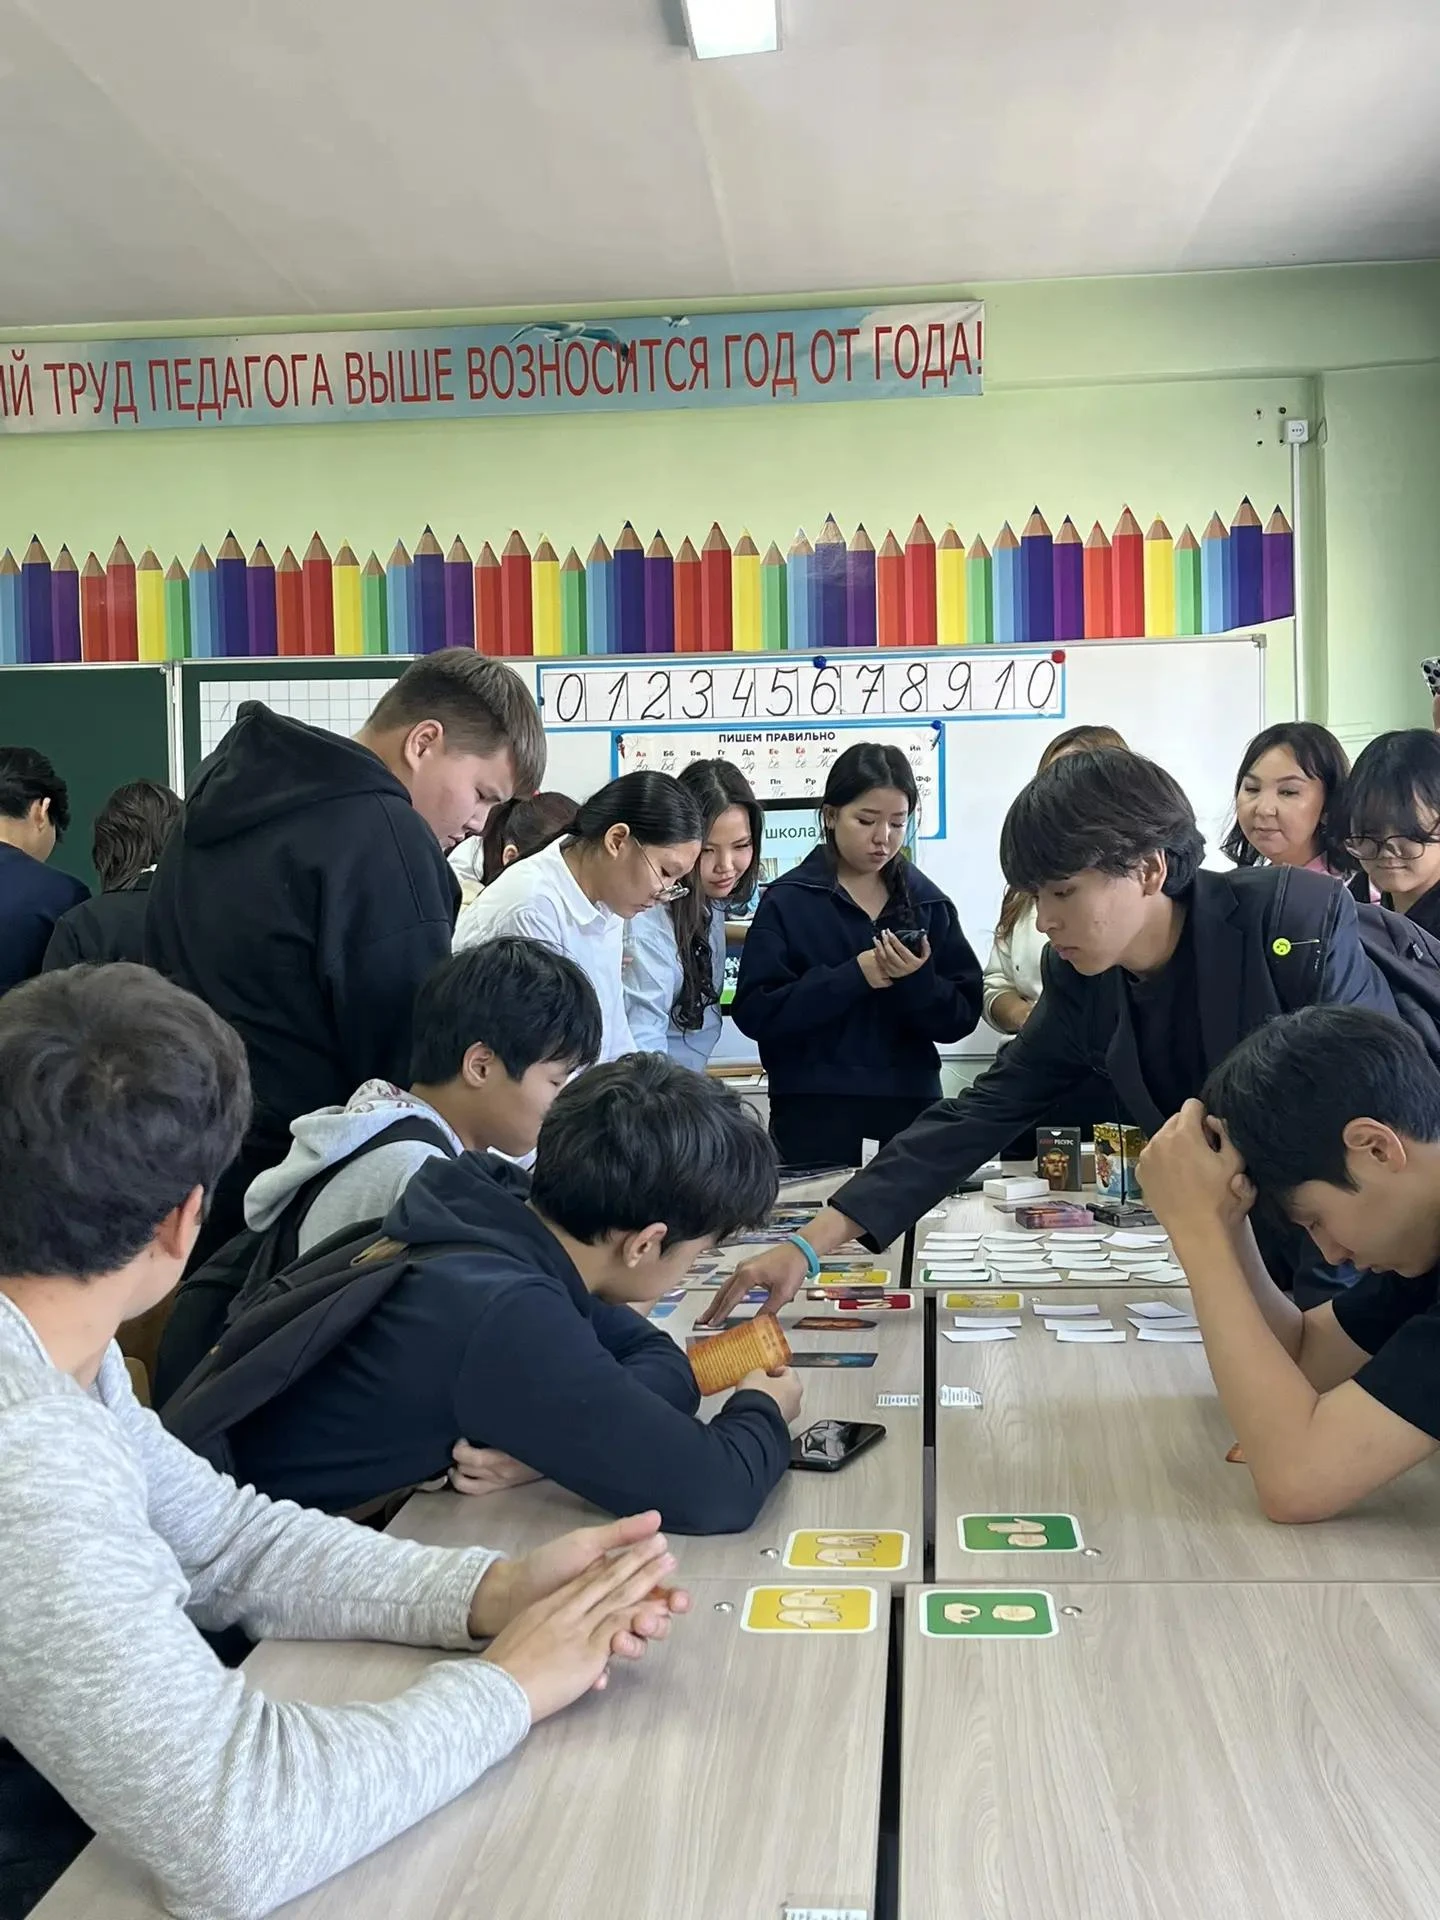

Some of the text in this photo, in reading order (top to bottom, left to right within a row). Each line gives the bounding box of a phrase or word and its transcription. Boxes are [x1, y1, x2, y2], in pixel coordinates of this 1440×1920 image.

[43, 360, 139, 424] ТРУД
[148, 353, 334, 421] ПЕДАГОГА
[345, 348, 455, 405] ВЫШЕ
[467, 336, 709, 400] ВОЗНОСИТСЯ
[724, 332, 797, 398] ГОД
[810, 328, 861, 384] ОТ
[873, 321, 983, 389] ГОДА!
[556, 673, 583, 722] 0
[608, 672, 628, 721] 1
[640, 671, 670, 720] 2
[682, 670, 713, 718] 3
[732, 669, 754, 717] 4
[765, 667, 798, 716] 5
[810, 666, 841, 715] 6
[856, 664, 885, 714] 7
[899, 663, 928, 712] 8
[943, 661, 971, 711] 9
[718, 731, 836, 743] ПИШЕМ ПРАВИЛЬНО
[764, 826, 817, 839] школа
